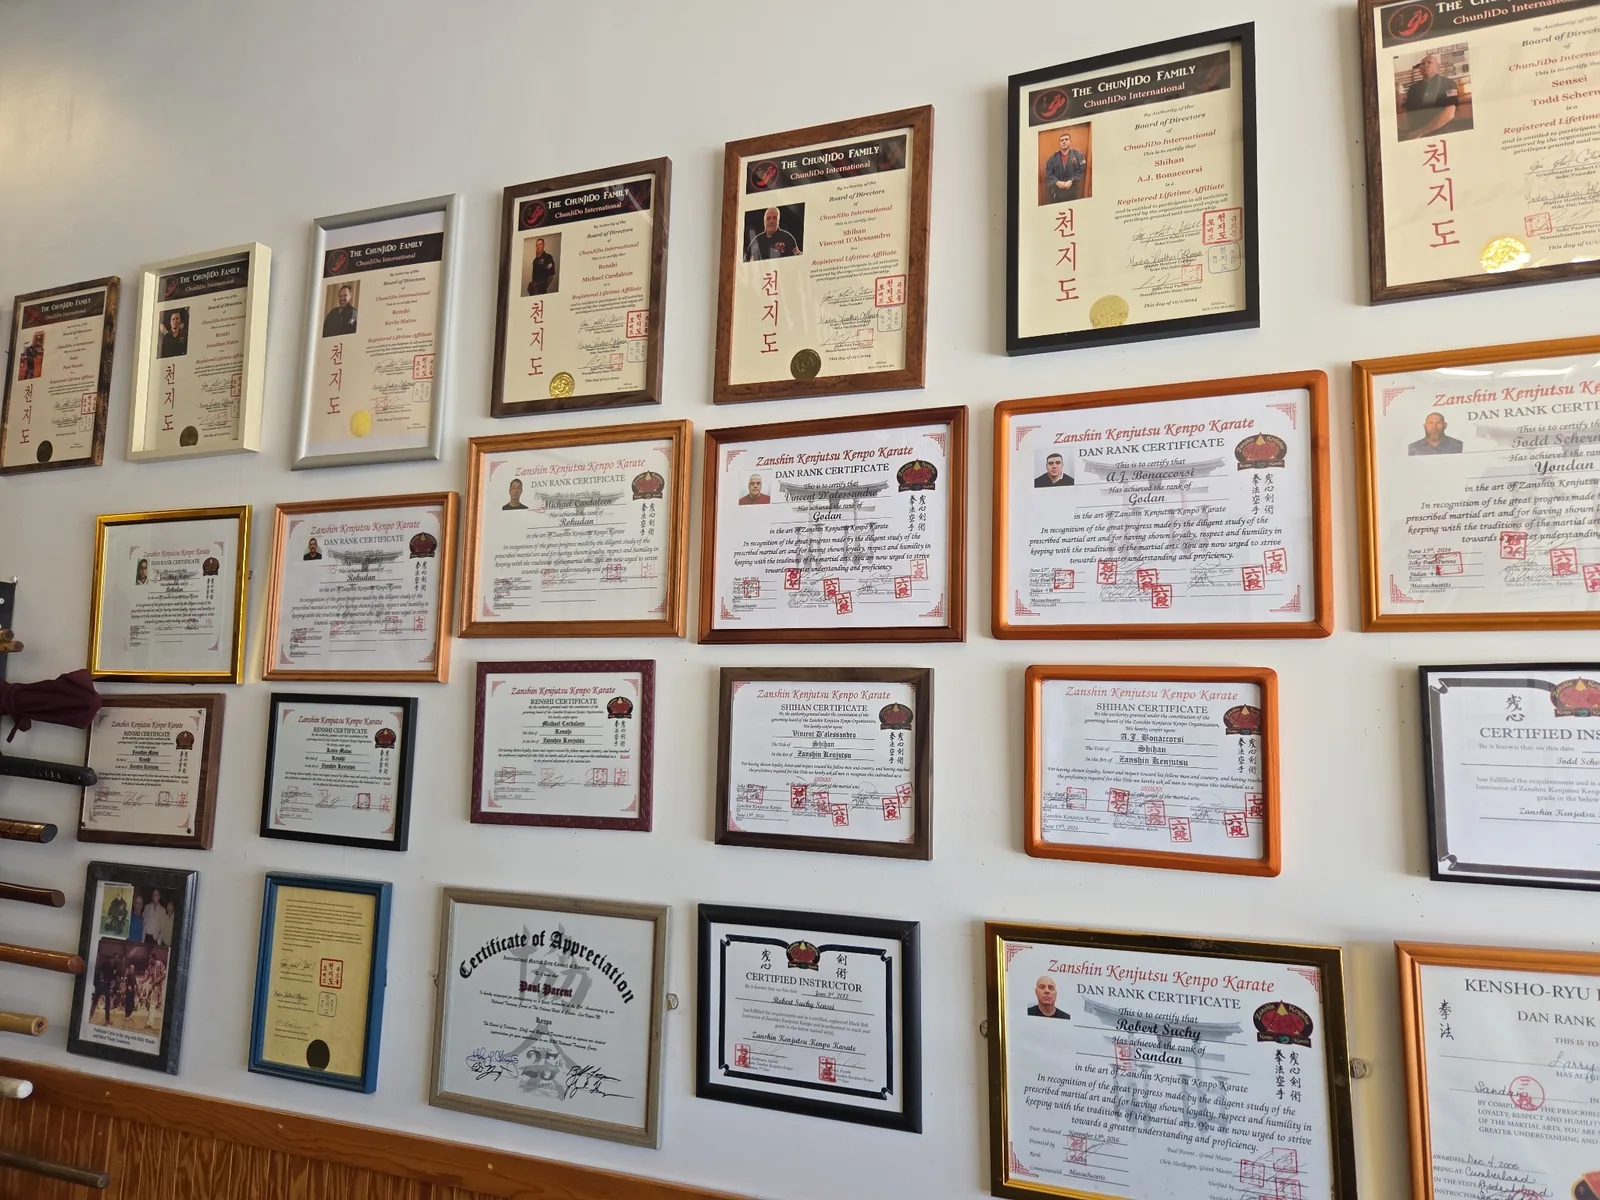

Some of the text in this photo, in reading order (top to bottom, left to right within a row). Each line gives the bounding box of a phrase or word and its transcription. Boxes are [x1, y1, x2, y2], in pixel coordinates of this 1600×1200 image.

[1552, 75, 1588, 88] Sensei
[1129, 82, 1185, 100] International
[1531, 94, 1559, 107] Todd
[1135, 119, 1159, 130] Board
[1169, 112, 1205, 125] Directors
[826, 160, 871, 174] International
[1155, 156, 1184, 167] Shihan
[1156, 166, 1203, 180] Bonaccorsi
[1117, 182, 1225, 205] Registered Lifetime Affiliate
[843, 227, 866, 236] Shihan
[819, 238, 845, 247] Vincent
[1433, 383, 1576, 407] Zanshin Kenjutsu
[1467, 406, 1547, 421] DAN RANK
[1054, 418, 1255, 446] Zanshin Kenjutsu Kenpo Karate
[1079, 437, 1224, 457] DAN RANK CERTIFICATE
[1512, 435, 1549, 448] Todd
[756, 446, 913, 467] Zanshin Kenjutsu Kenpo Karate
[515, 459, 646, 476] Zanshin Kenjutsu Kenpo Karate
[775, 463, 889, 479] DAN RANK CERTIFICATE
[1132, 468, 1195, 480] Bonaccorsi
[1534, 460, 1595, 475] Yondan
[549, 478, 571, 486] RANK
[573, 475, 626, 484] CERTIFICATE
[1129, 494, 1166, 506] Godan
[813, 511, 842, 522] Godan
[757, 689, 890, 701] Zanshin Kenjutsu Kenpo Karate
[1066, 686, 1238, 701] Zanshin Kenjutsu Kenpo Karate
[1096, 703, 1208, 714] SHIHAN CERTIFICATE
[792, 730, 814, 738] Vincent
[1141, 734, 1185, 743] Bonaccorsi
[1480, 727, 1572, 740] CERTIFIED
[1138, 744, 1166, 754] Shihan
[1119, 756, 1188, 767] Zanshin Kenjutsu
[1556, 757, 1577, 765] Todd
[1519, 808, 1552, 816] Zanshin
[459, 930, 634, 1004] Certificate of Appreciation
[746, 972, 862, 992] CERTIFIED INSTRUCTOR
[1048, 959, 1274, 992] Zanshin Kenjutsu Kenpo Karate
[519, 981, 573, 997] Paul Parent
[1464, 978, 1590, 1000] KENSHO-RYU
[772, 996, 793, 1006] Robert
[816, 1002, 835, 1010] Sensei
[1077, 984, 1241, 1010] DAN RANK CERTIFICATE
[1118, 1007, 1198, 1023] This is to certify that
[1517, 1011, 1596, 1027] DAN RANK
[1116, 1020, 1202, 1042] Robert Suchy
[1134, 1048, 1183, 1065] Sandan
[1465, 1167, 1536, 1183] Cumberland
